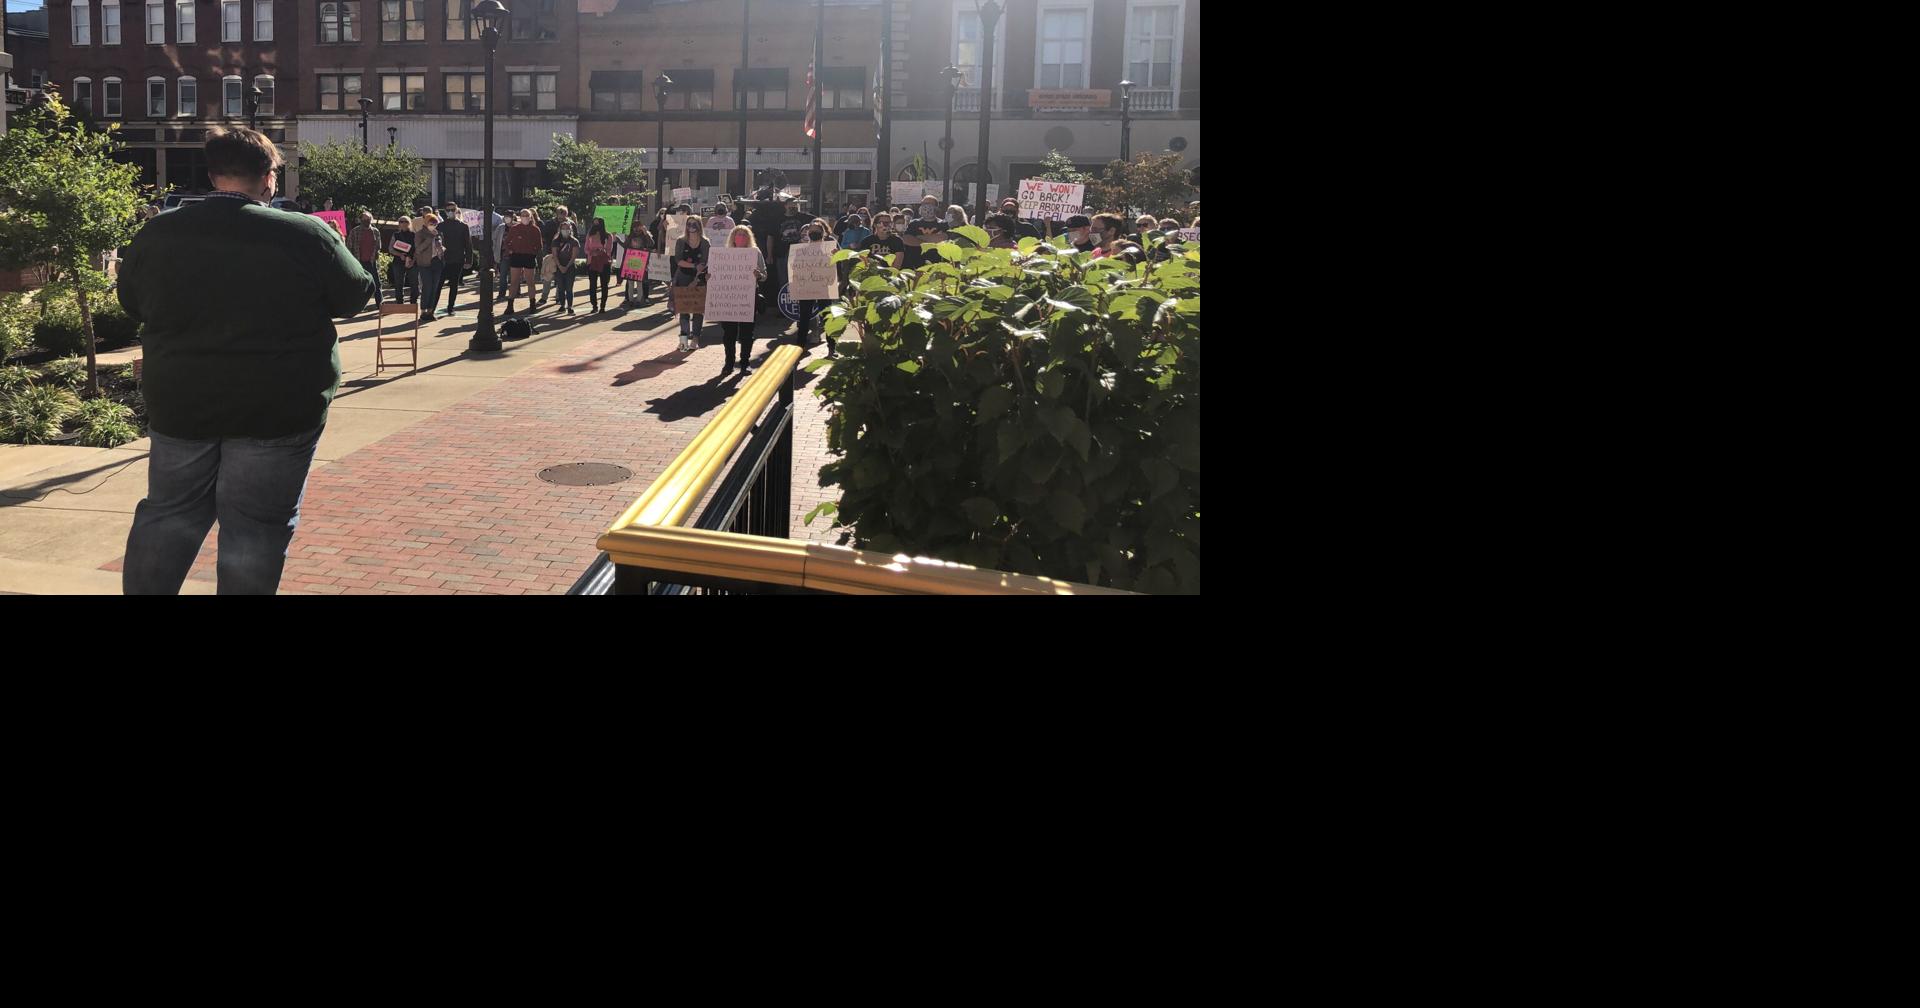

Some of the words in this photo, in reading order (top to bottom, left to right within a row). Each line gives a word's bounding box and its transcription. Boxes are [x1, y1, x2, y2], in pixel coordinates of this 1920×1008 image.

[1026, 182, 1043, 191] WE
[1021, 190, 1034, 200] GO
[1040, 192, 1070, 203] BACK!
[1019, 200, 1038, 209] KEEP
[1039, 202, 1082, 214] ABORTION
[870, 243, 891, 255] Pitt
